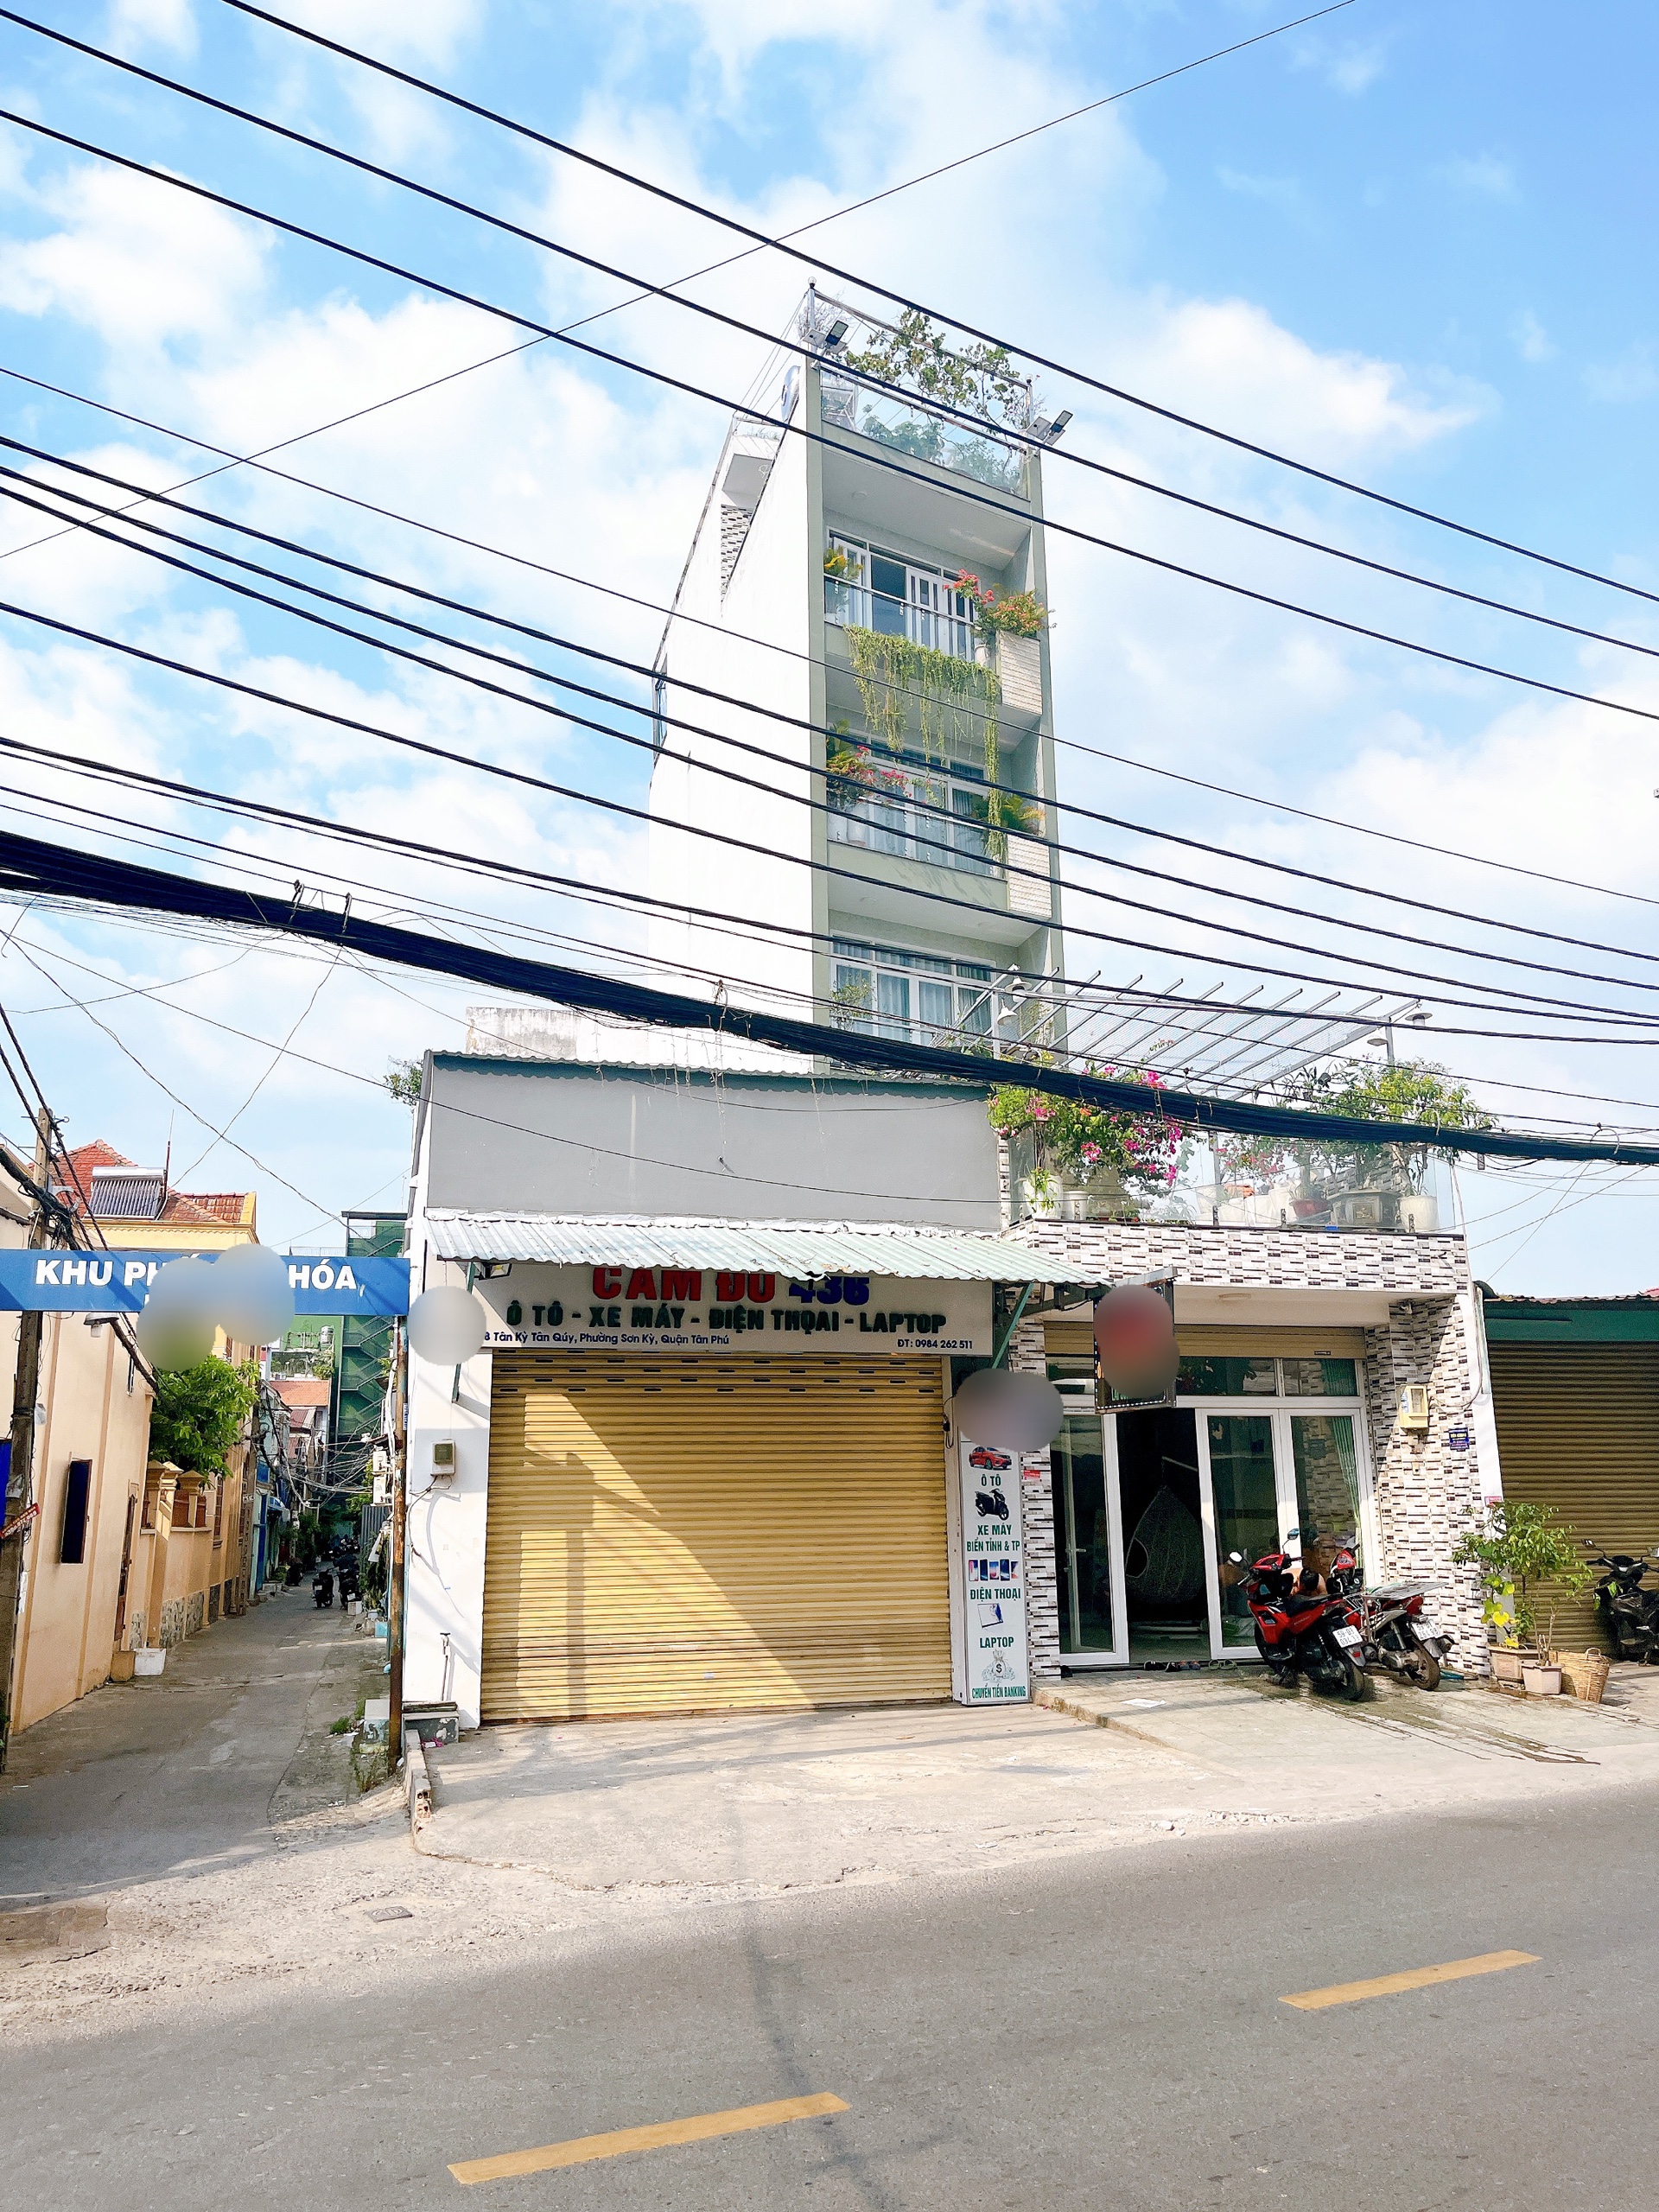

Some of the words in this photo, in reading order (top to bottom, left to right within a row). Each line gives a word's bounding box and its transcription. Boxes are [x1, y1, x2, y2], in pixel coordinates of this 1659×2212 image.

[35, 1259, 113, 1287] KHU
[506, 1300, 522, 1326] Ô
[532, 1300, 563, 1326] TÔ
[588, 1306, 621, 1328] XE
[631, 1303, 685, 1329] MÁY
[709, 1305, 765, 1333] ĐIỆN
[860, 1312, 947, 1334] LAPTOP
[493, 1332, 512, 1342] Tân
[515, 1331, 528, 1344] Kỳ
[531, 1332, 550, 1342] Tân
[579, 1332, 618, 1344] Phường
[620, 1333, 639, 1343] Sơn
[660, 1334, 689, 1345] Quận
[690, 1334, 709, 1344] Tân
[710, 1334, 729, 1344] Phú
[915, 1338, 938, 1348] 0984
[940, 1339, 957, 1349] 262
[959, 1340, 973, 1350] 511
[981, 1473, 987, 1486] Ô
[989, 1473, 1001, 1486] TÔ
[977, 1524, 989, 1535] XE
[991, 1522, 1012, 1535] MÁY
[1011, 1540, 1020, 1551] TP
[969, 1586, 992, 1602] ĐIỆN
[994, 1588, 1020, 1601] THOẠI
[979, 1637, 1014, 1649] LAPTOP
